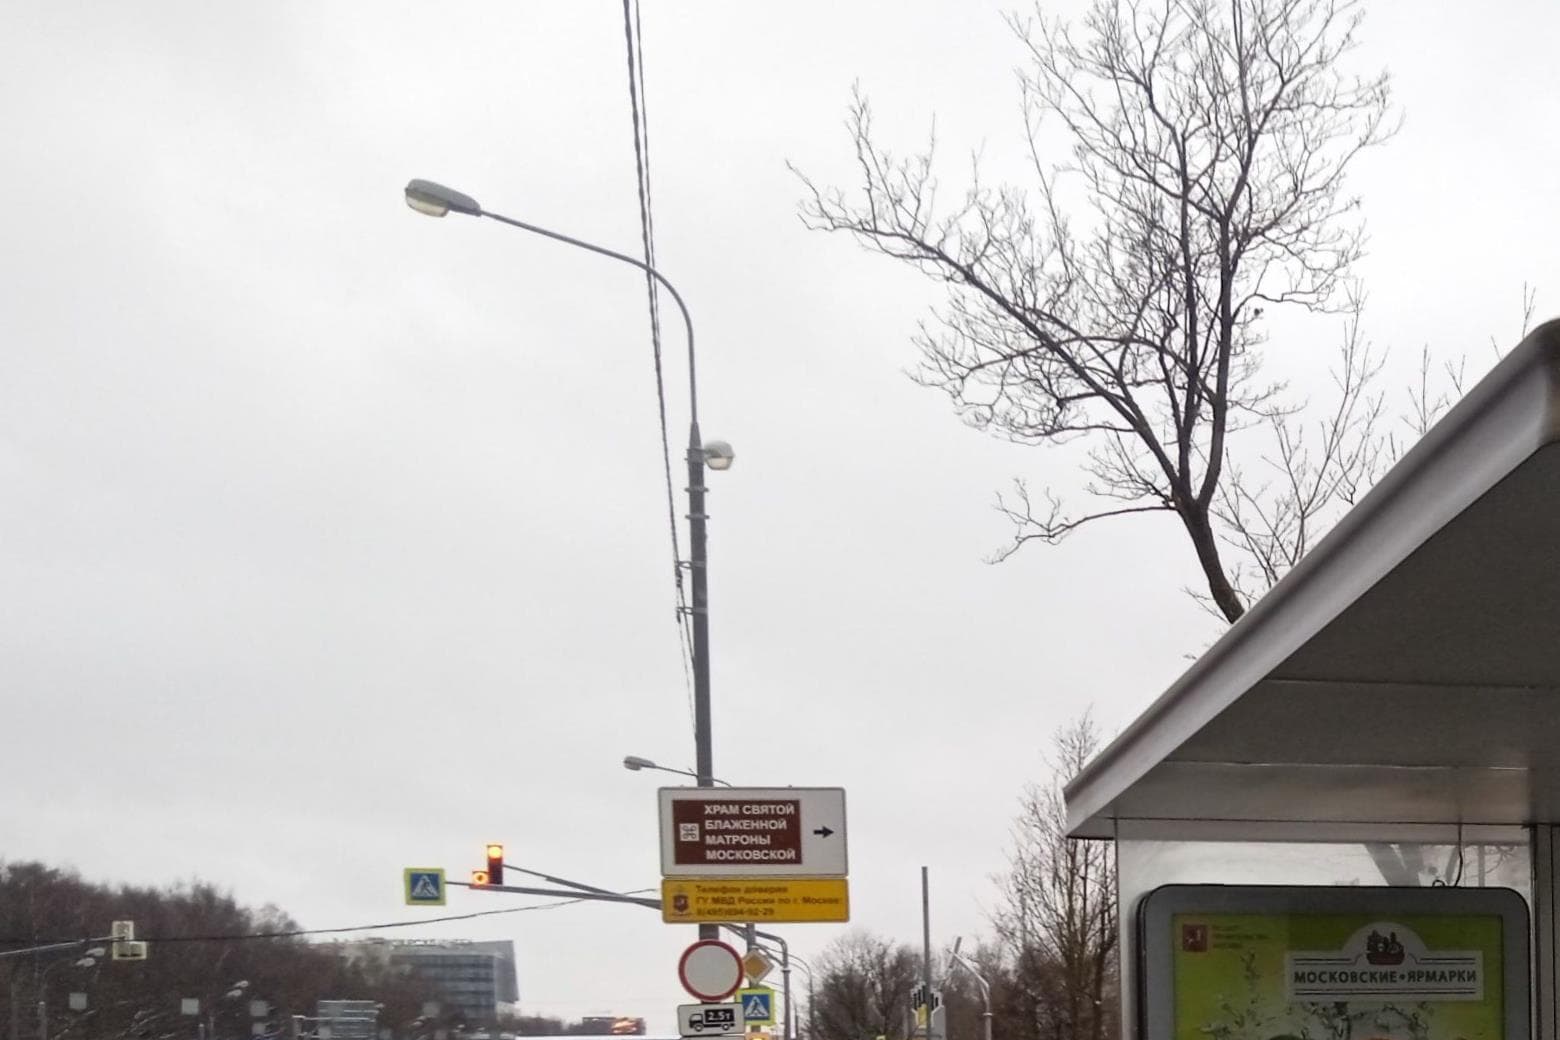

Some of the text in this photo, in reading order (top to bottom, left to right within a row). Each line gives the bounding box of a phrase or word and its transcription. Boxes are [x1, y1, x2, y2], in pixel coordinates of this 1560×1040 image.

[704, 803, 794, 815] ХРАМ СВЯТОЙ
[705, 818, 787, 830] БЛАЖЕННОЙ
[705, 834, 771, 845] МАТРОНЫ
[706, 848, 796, 860] МОСКОВСКОЙ
[696, 885, 741, 894] Телефон
[711, 897, 734, 905] МВД
[738, 897, 775, 905] России
[1293, 969, 1477, 984] МОСКОВСКИЕ ЯРМАРКИ
